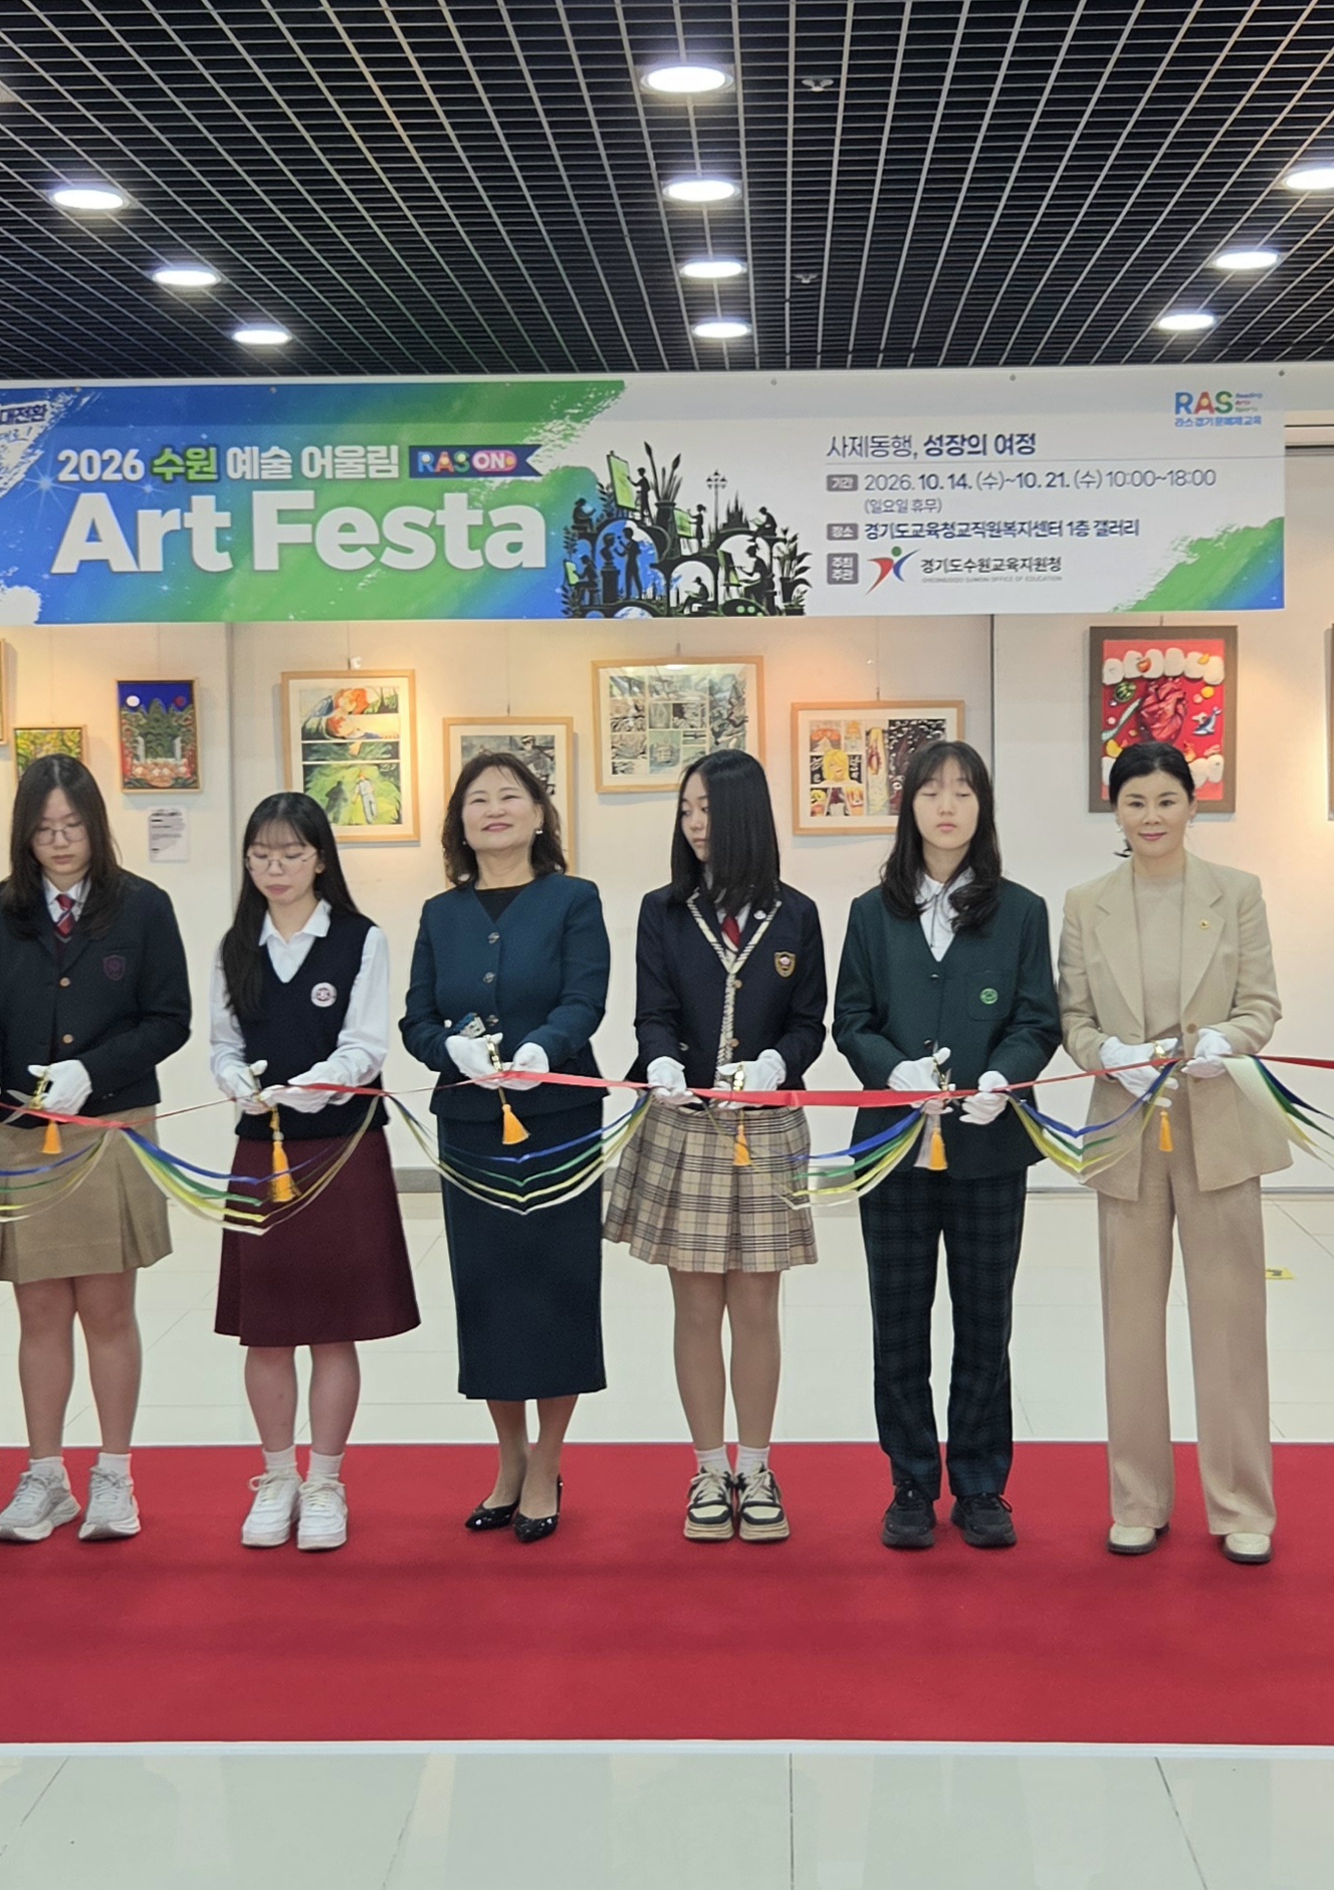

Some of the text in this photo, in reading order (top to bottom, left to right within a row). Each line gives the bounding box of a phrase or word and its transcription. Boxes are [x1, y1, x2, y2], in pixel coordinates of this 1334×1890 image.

[1175, 391, 1233, 414] RAS
[826, 433, 1036, 460] 사제동행, 성장의 여정
[57, 445, 400, 482] 2026 수원 예술 어울림
[865, 474, 916, 491] 2026.
[919, 474, 945, 490] 10.
[948, 473, 973, 489] 14.
[1046, 472, 1070, 488] 21.
[1107, 469, 1216, 488] 10:00~18:00
[864, 498, 943, 514] (일요일 휴무)
[50, 489, 547, 574] Art Festa
[865, 519, 1140, 540] 경기도교육청교직원복지센터 1층 갤러리
[920, 557, 1062, 574] 경기도수원교육지원청
